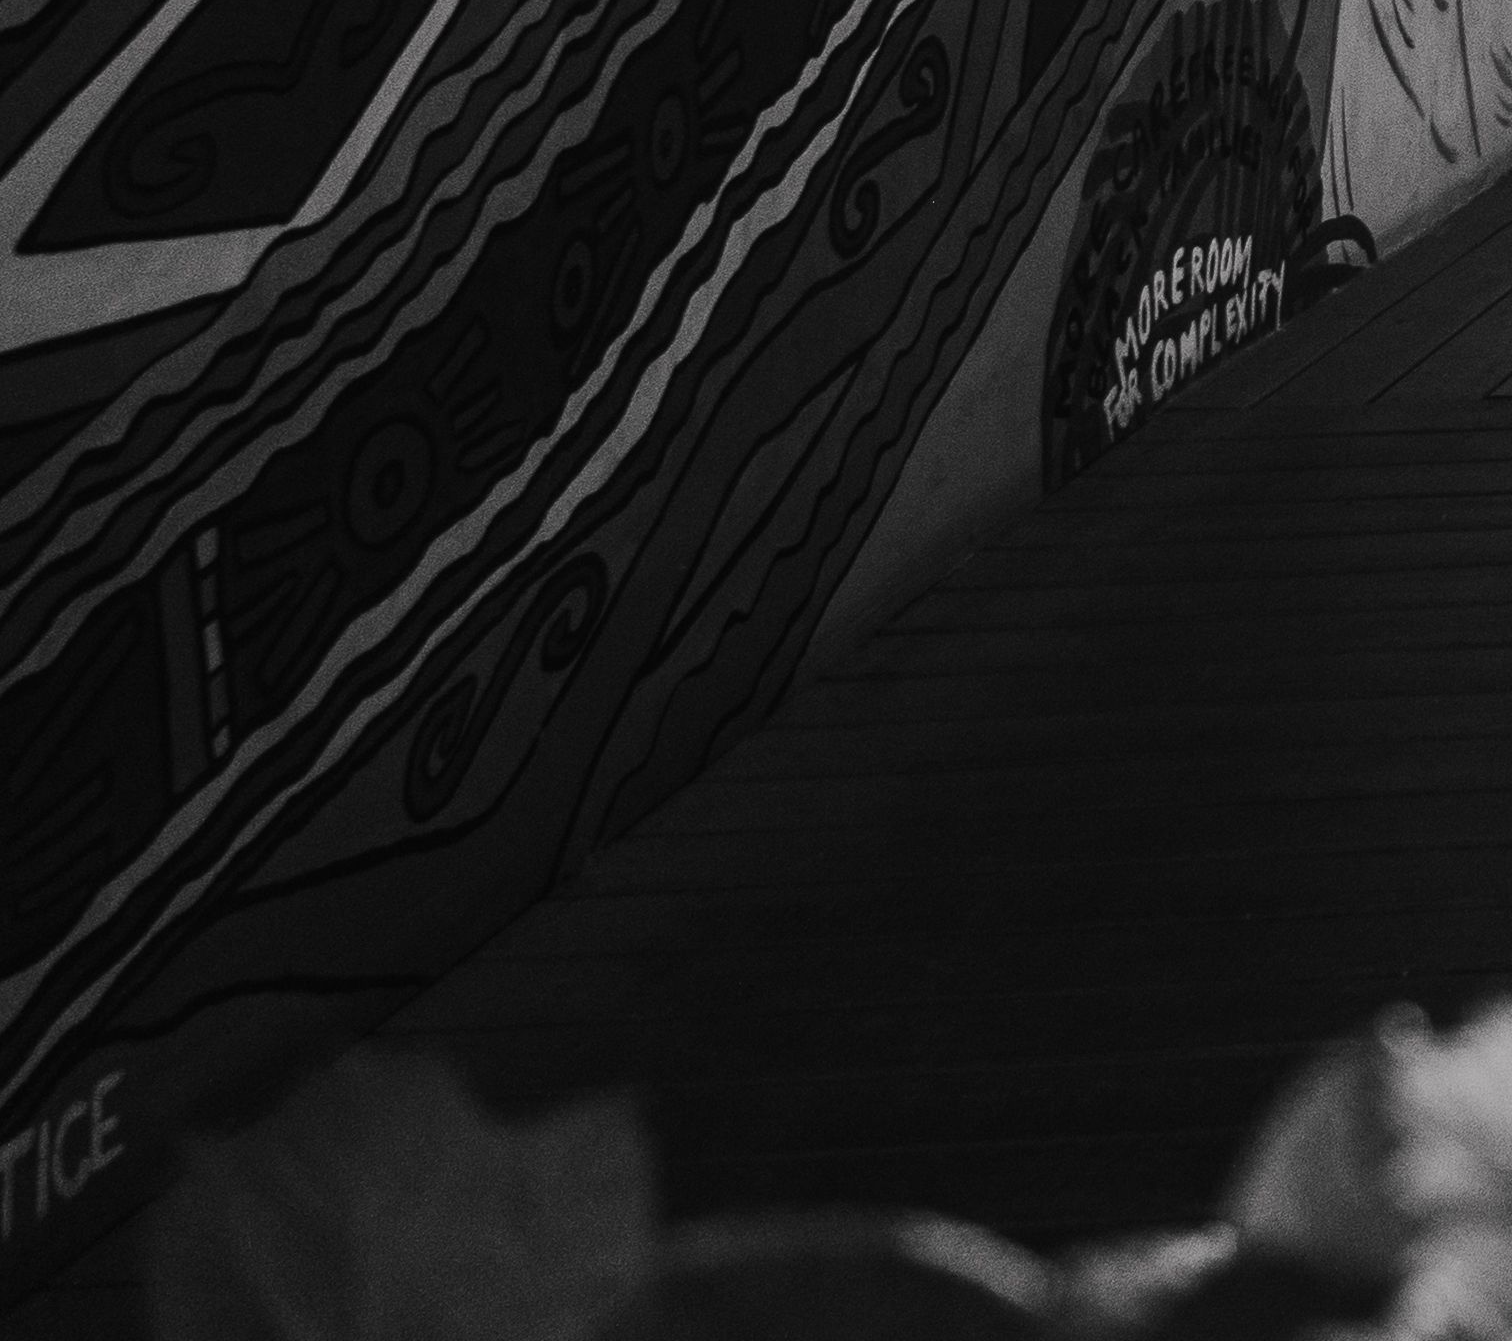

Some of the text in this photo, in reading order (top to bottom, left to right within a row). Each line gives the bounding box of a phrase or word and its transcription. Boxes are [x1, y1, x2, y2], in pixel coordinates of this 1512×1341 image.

[1111, 38, 1255, 193] CAREFREE
[1102, 259, 1287, 444] FOR COMPLEXITY
[1114, 232, 1255, 383] MORE ROOM
